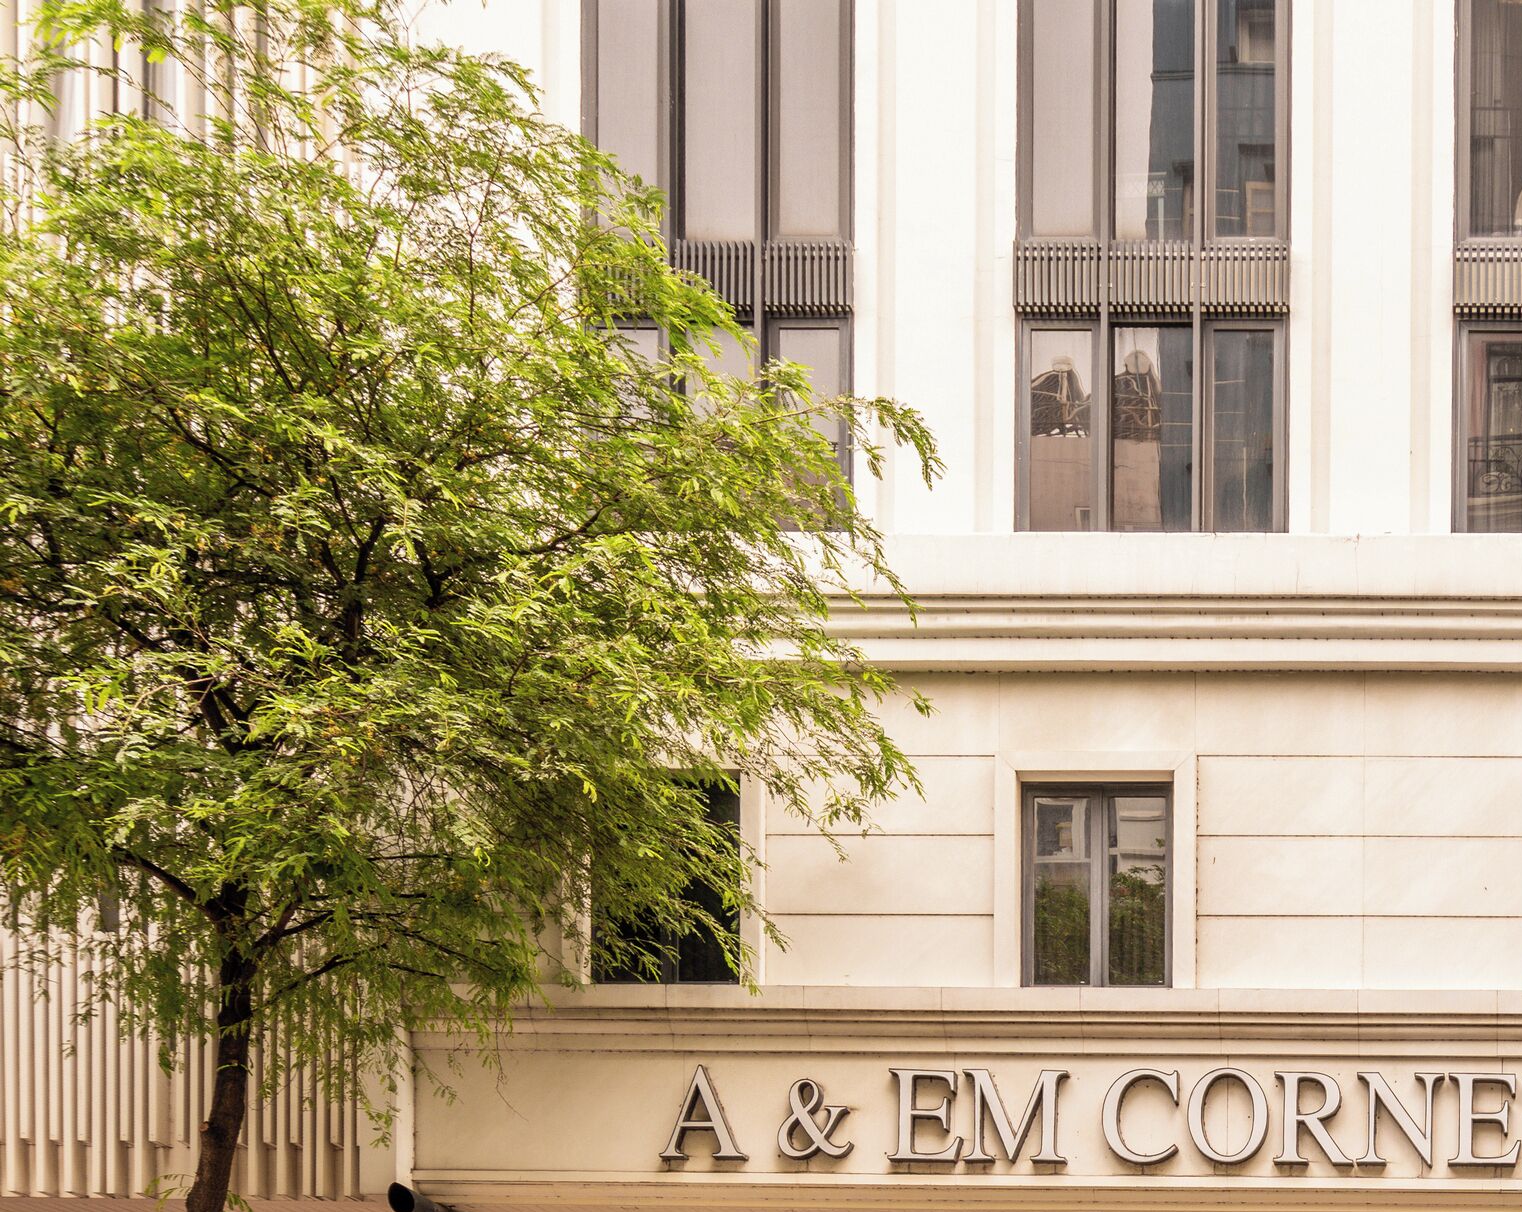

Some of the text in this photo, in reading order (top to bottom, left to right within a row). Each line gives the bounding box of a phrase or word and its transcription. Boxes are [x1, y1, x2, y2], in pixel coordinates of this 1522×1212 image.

[659, 1065, 749, 1161] A
[776, 1078, 855, 1161] &
[887, 1067, 1070, 1166] EM
